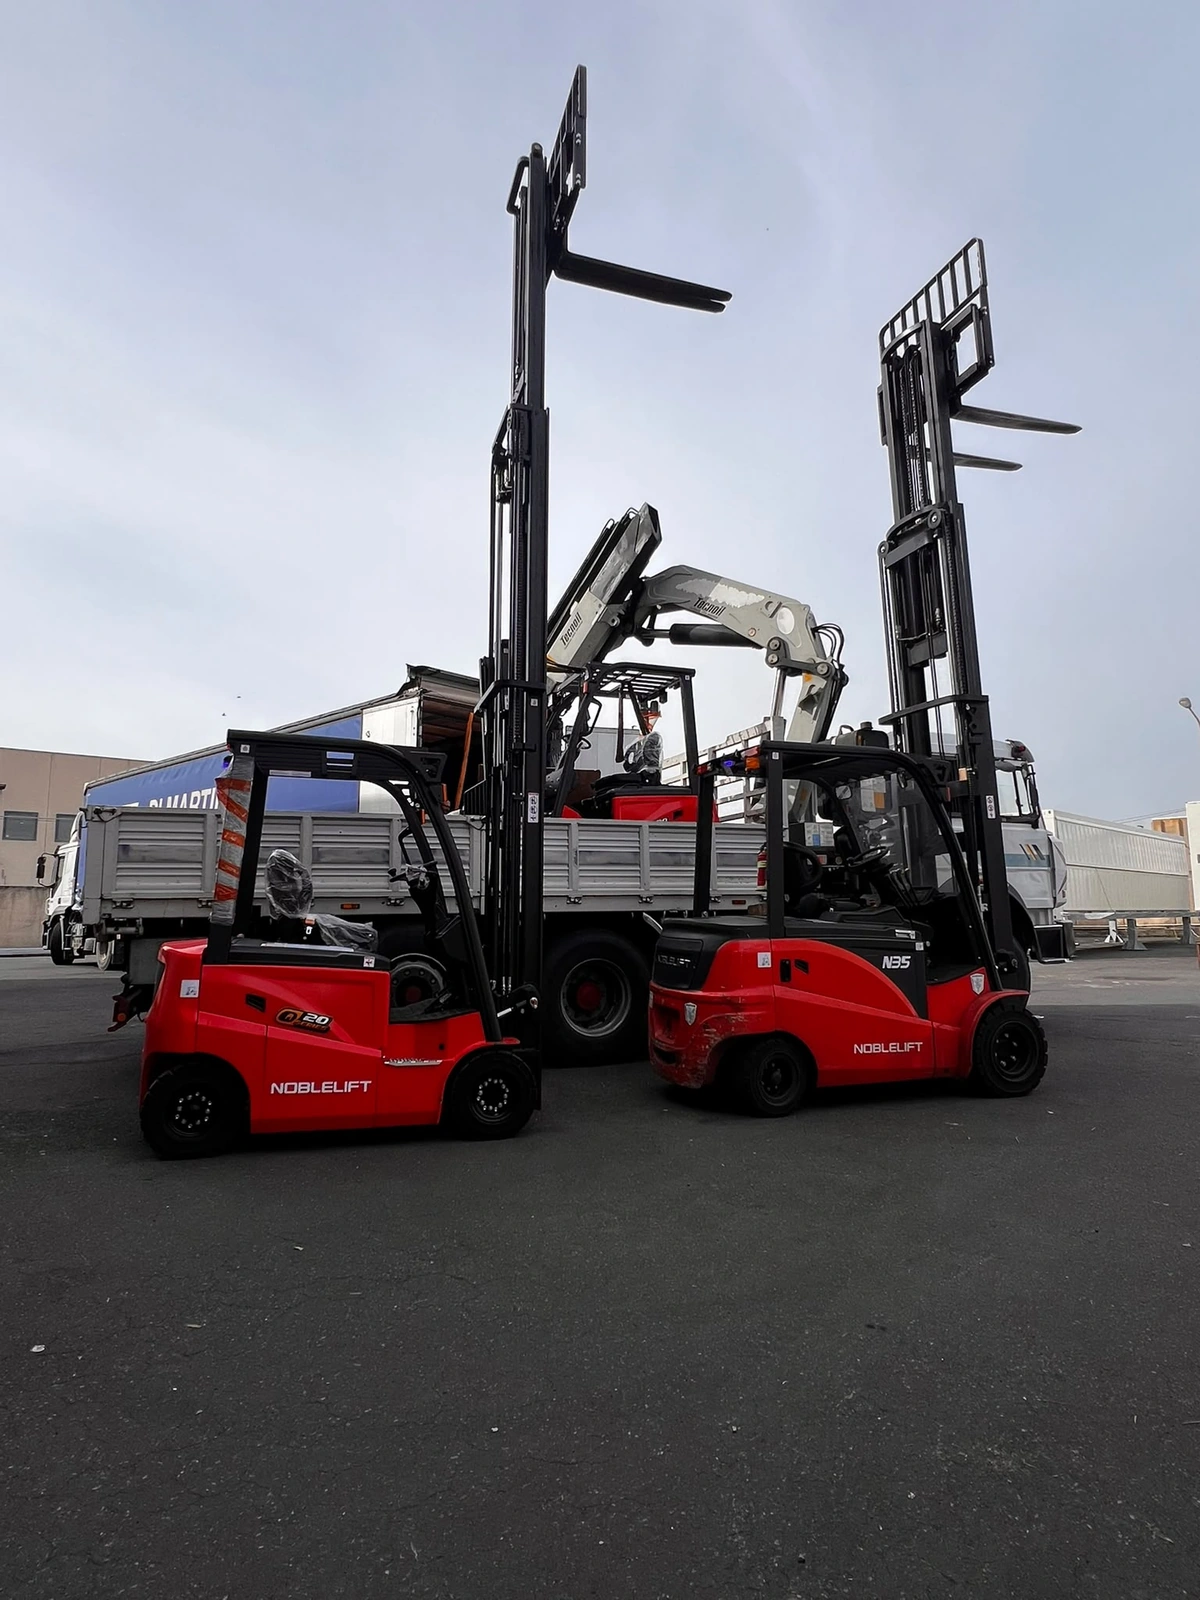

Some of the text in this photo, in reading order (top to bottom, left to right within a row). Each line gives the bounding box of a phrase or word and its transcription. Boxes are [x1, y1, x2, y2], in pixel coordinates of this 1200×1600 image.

[694, 597, 727, 617] Tecnoil
[561, 612, 582, 646] Tecnoil
[882, 955, 911, 969] N35
[302, 1012, 330, 1025] 20
[853, 1041, 924, 1054] NOBLELIFT
[270, 1080, 372, 1095] NOBLELIFT
